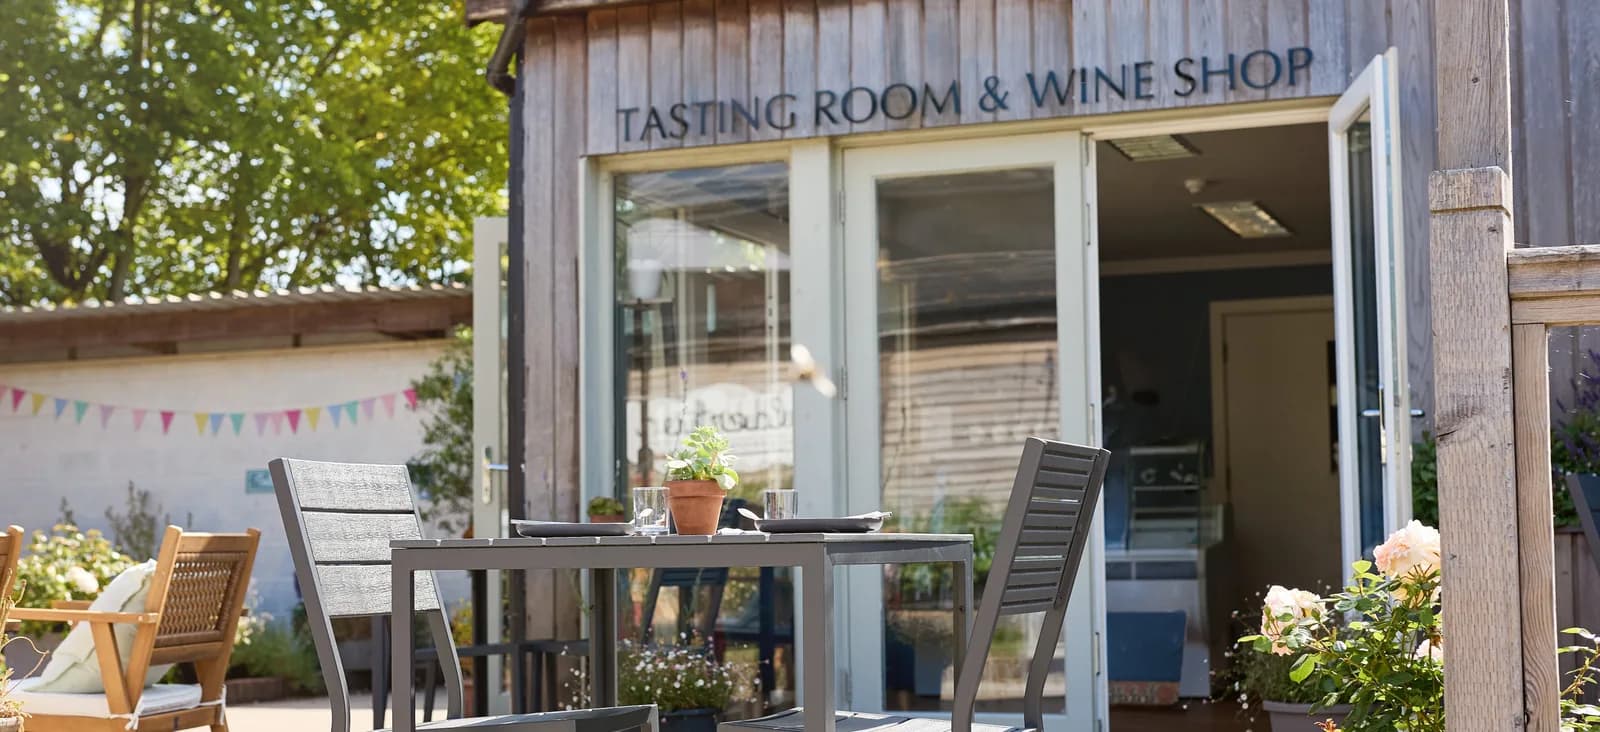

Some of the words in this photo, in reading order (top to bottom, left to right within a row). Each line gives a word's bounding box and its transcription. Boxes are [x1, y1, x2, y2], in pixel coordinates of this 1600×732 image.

[616, 94, 798, 142] TASTING
[815, 80, 962, 127] ROOM
[978, 75, 1010, 113] &
[1026, 61, 1155, 108] WINE
[1173, 47, 1314, 98] SHOP
